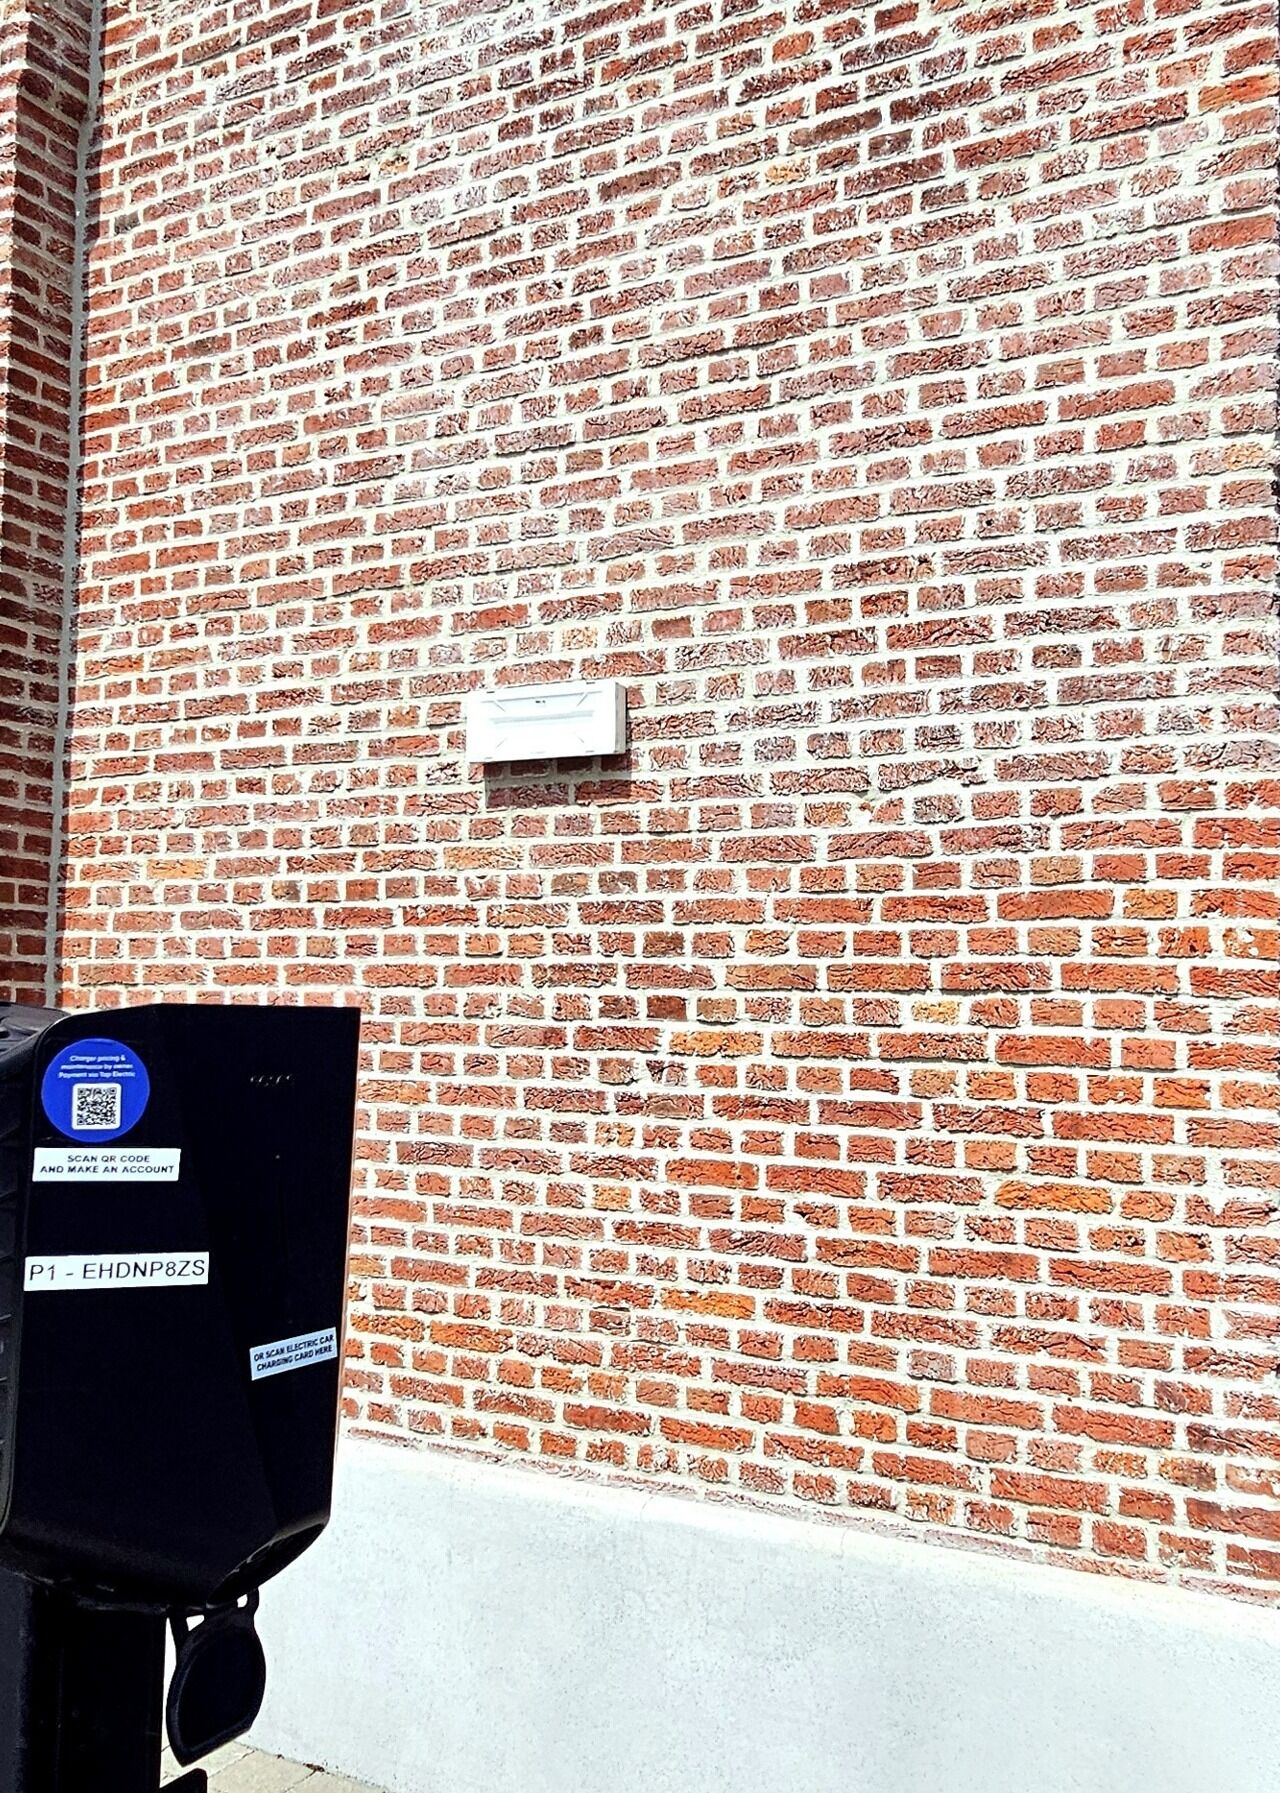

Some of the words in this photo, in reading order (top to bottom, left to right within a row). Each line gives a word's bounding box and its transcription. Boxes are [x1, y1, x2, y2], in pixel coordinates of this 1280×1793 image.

[40, 1165, 64, 1173] AND
[67, 1165, 99, 1173] MAKE
[102, 1165, 118, 1173] AN
[121, 1165, 175, 1173] ACCOUNT
[67, 1155, 98, 1163] SCAN
[101, 1155, 117, 1163] QR
[120, 1155, 151, 1163] CODE
[29, 1264, 56, 1281] P1
[82, 1259, 206, 1280] EHDNP8ZS
[253, 1353, 264, 1362] OR
[266, 1348, 285, 1359] SCAN
[286, 1338, 319, 1353] ELECTRIC
[319, 1334, 335, 1345] CAR
[256, 1356, 293, 1372] CHARGING
[294, 1350, 314, 1362] CARD
[314, 1344, 333, 1356] HERE
